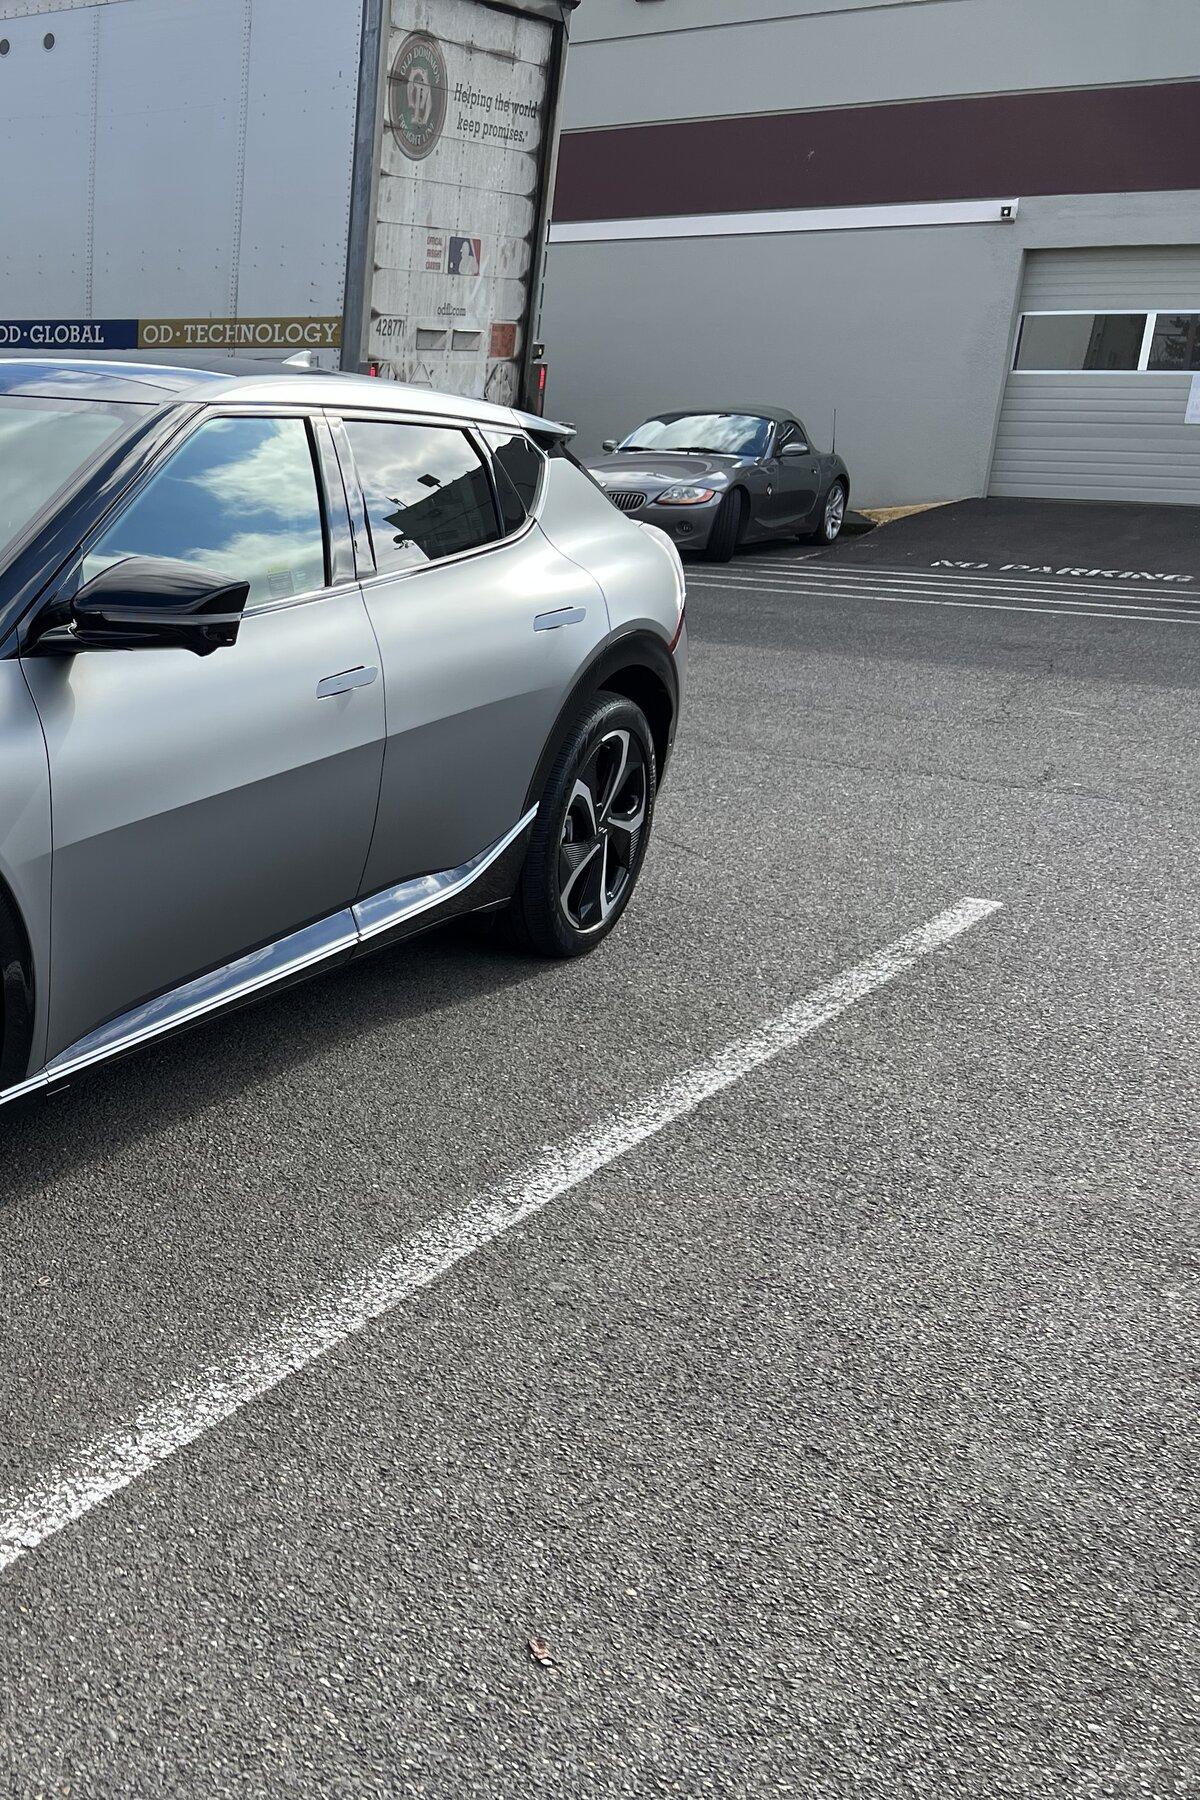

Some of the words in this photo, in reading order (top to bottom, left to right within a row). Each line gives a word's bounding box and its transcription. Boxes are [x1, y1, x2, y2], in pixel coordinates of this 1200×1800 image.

[453, 82, 493, 114] Helping
[494, 96, 510, 114] the
[511, 101, 538, 119] world
[456, 112, 481, 135] keep
[930, 559, 990, 569] NO
[999, 563, 1194, 582] PARKING
